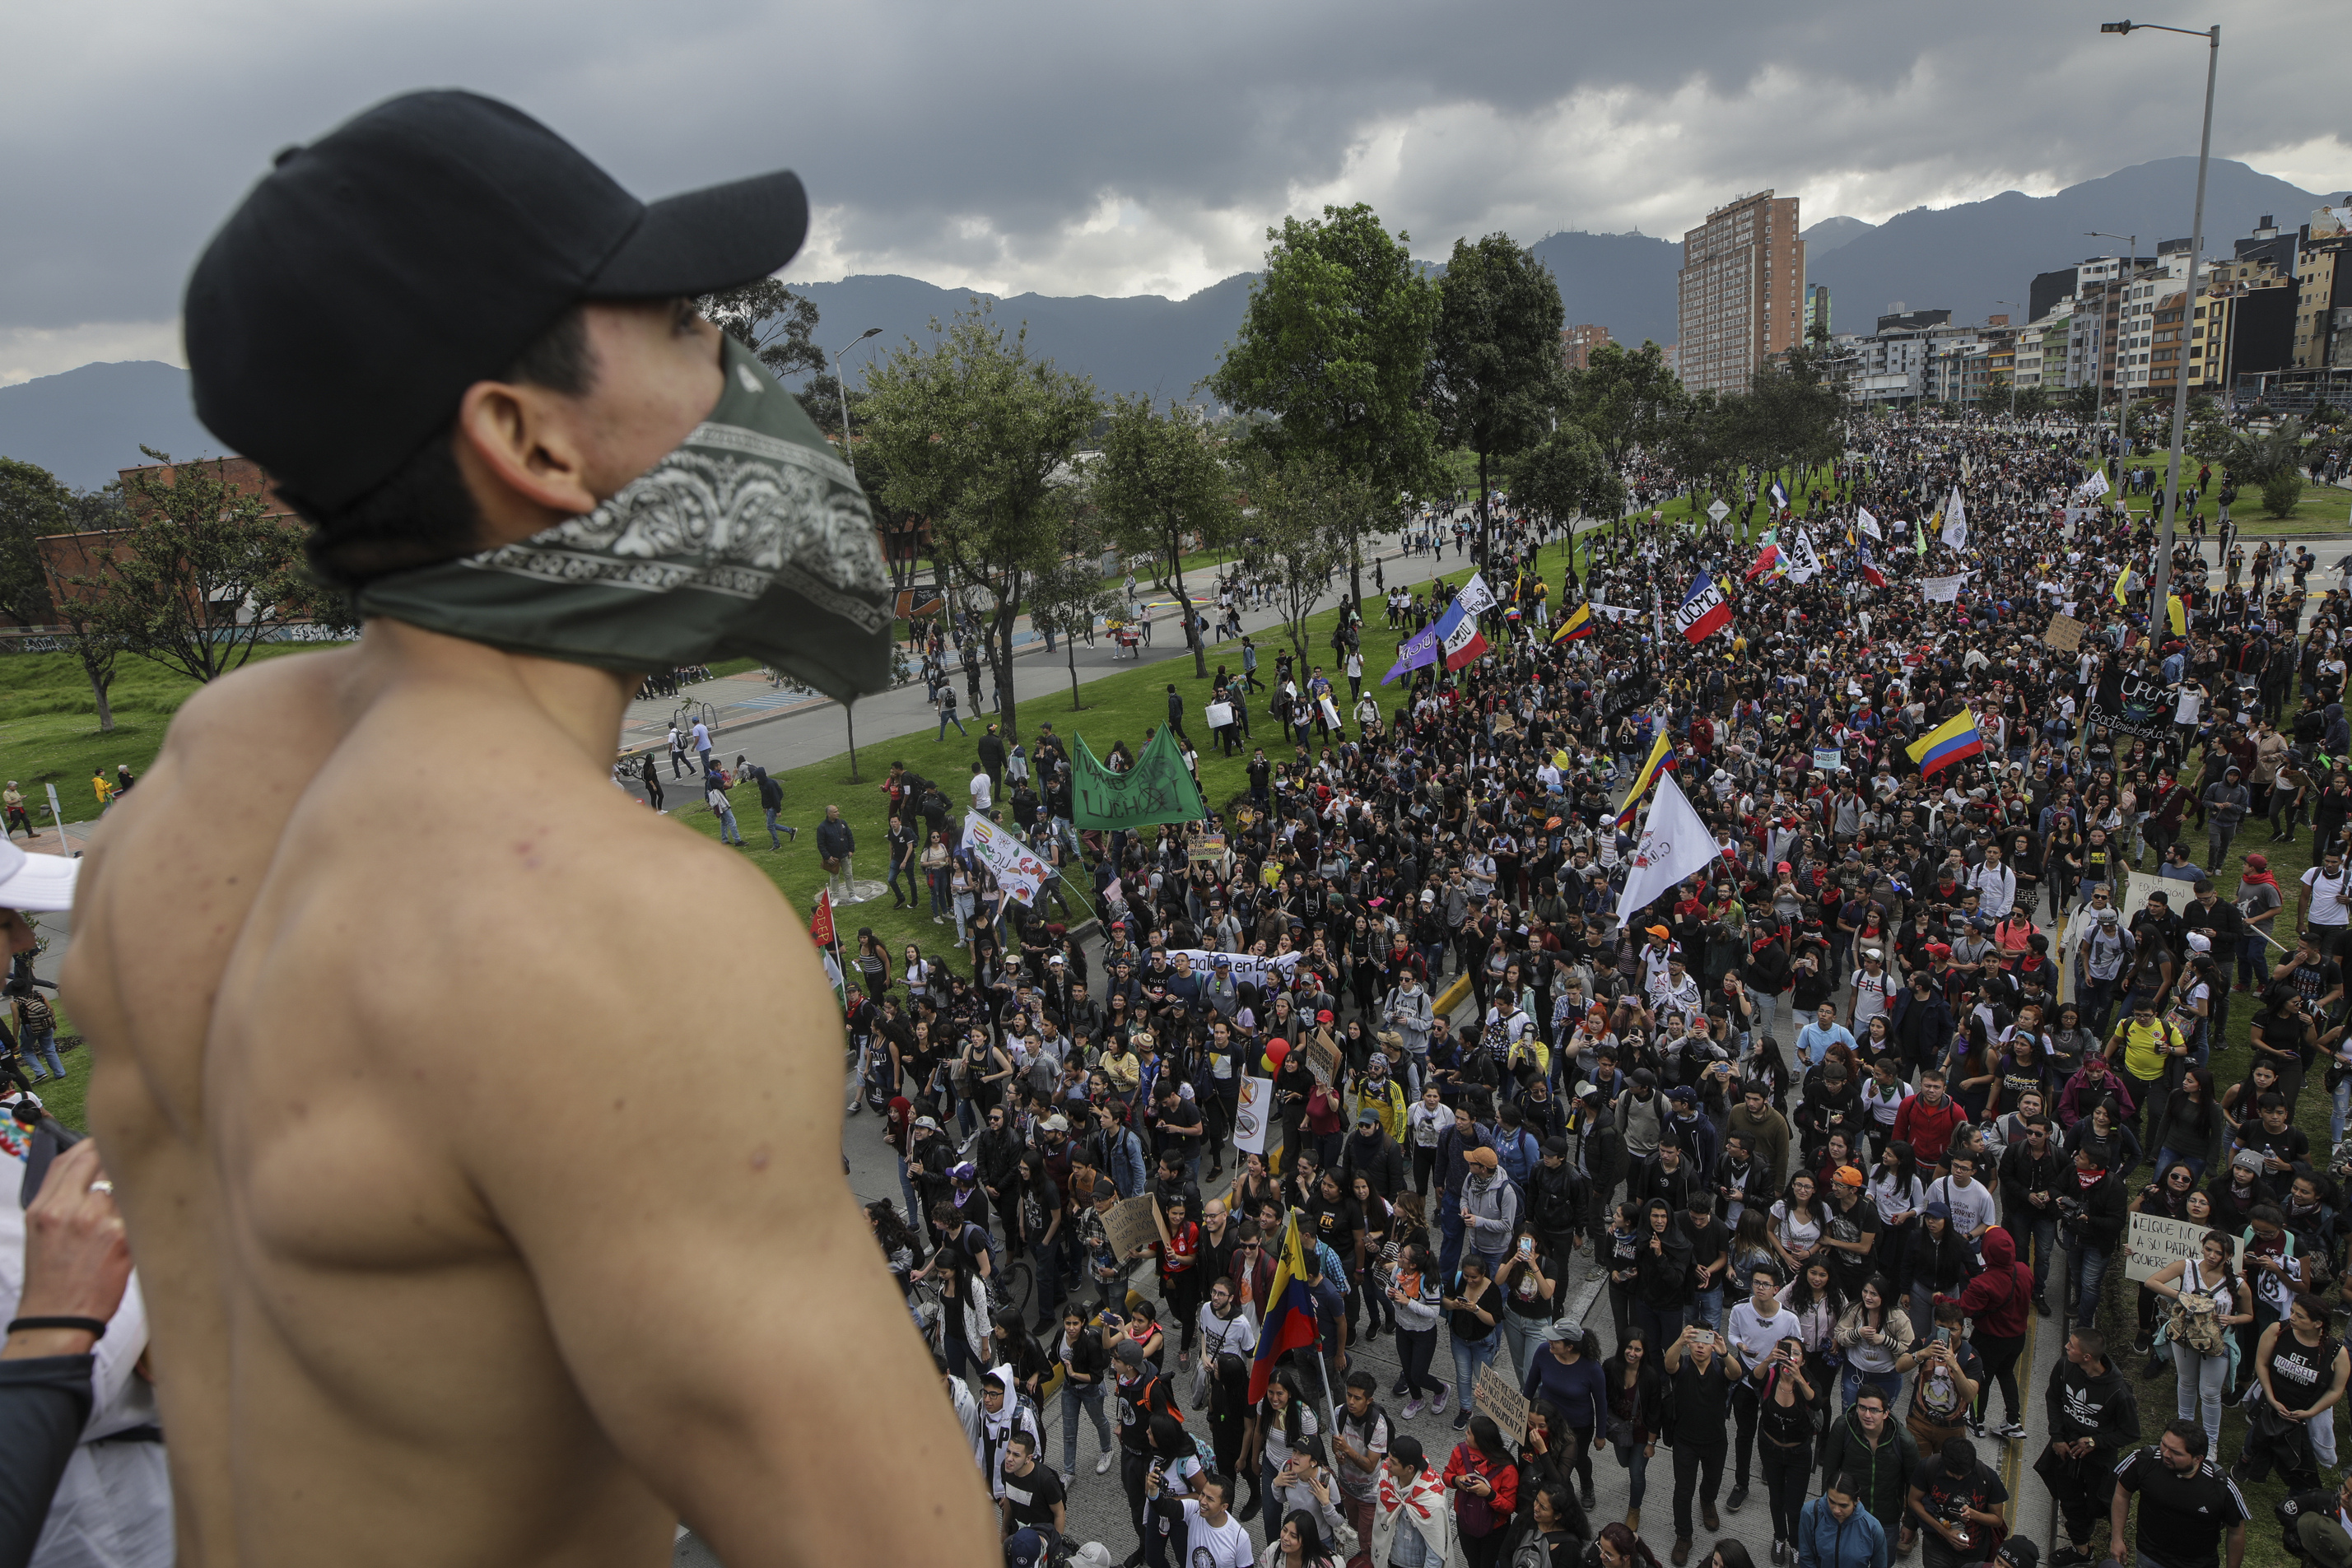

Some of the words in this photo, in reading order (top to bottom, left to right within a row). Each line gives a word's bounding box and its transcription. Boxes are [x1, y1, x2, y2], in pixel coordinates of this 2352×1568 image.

[1677, 588, 1719, 626] UCMC
[2088, 703, 2164, 739] Bacteriología
[2152, 876, 2163, 886] LA
[1235, 961, 1252, 973] en
[1255, 956, 1294, 982] Biolog
[1865, 979, 1875, 993] H
[1316, 1041, 1333, 1061] PUEBLO
[1306, 1055, 1330, 1089] CAMINA
[1104, 1200, 1144, 1226] NUESTROS
[1116, 1229, 1133, 1244] SUS
[1136, 1219, 1157, 1231] BÓM
[2179, 1226, 2196, 1241] NO
[2136, 1235, 2145, 1249] A
[2147, 1237, 2161, 1250] SU
[2165, 1240, 2200, 1260] PATRIA
[2131, 1252, 2168, 1269] QUIERE
[2275, 1355, 2317, 1380] YOURSELF
[2289, 1352, 2308, 1366] GET
[1479, 1376, 1488, 1391] NO
[1488, 1386, 1499, 1402] NOS
[1499, 1395, 1526, 1423] ASUSTA:
[1482, 1366, 1492, 1381] SU
[1492, 1375, 1525, 1409] REPRESIÓN
[1488, 1400, 1522, 1438] ARGUMENTA
[2063, 1404, 2099, 1428] adidas
